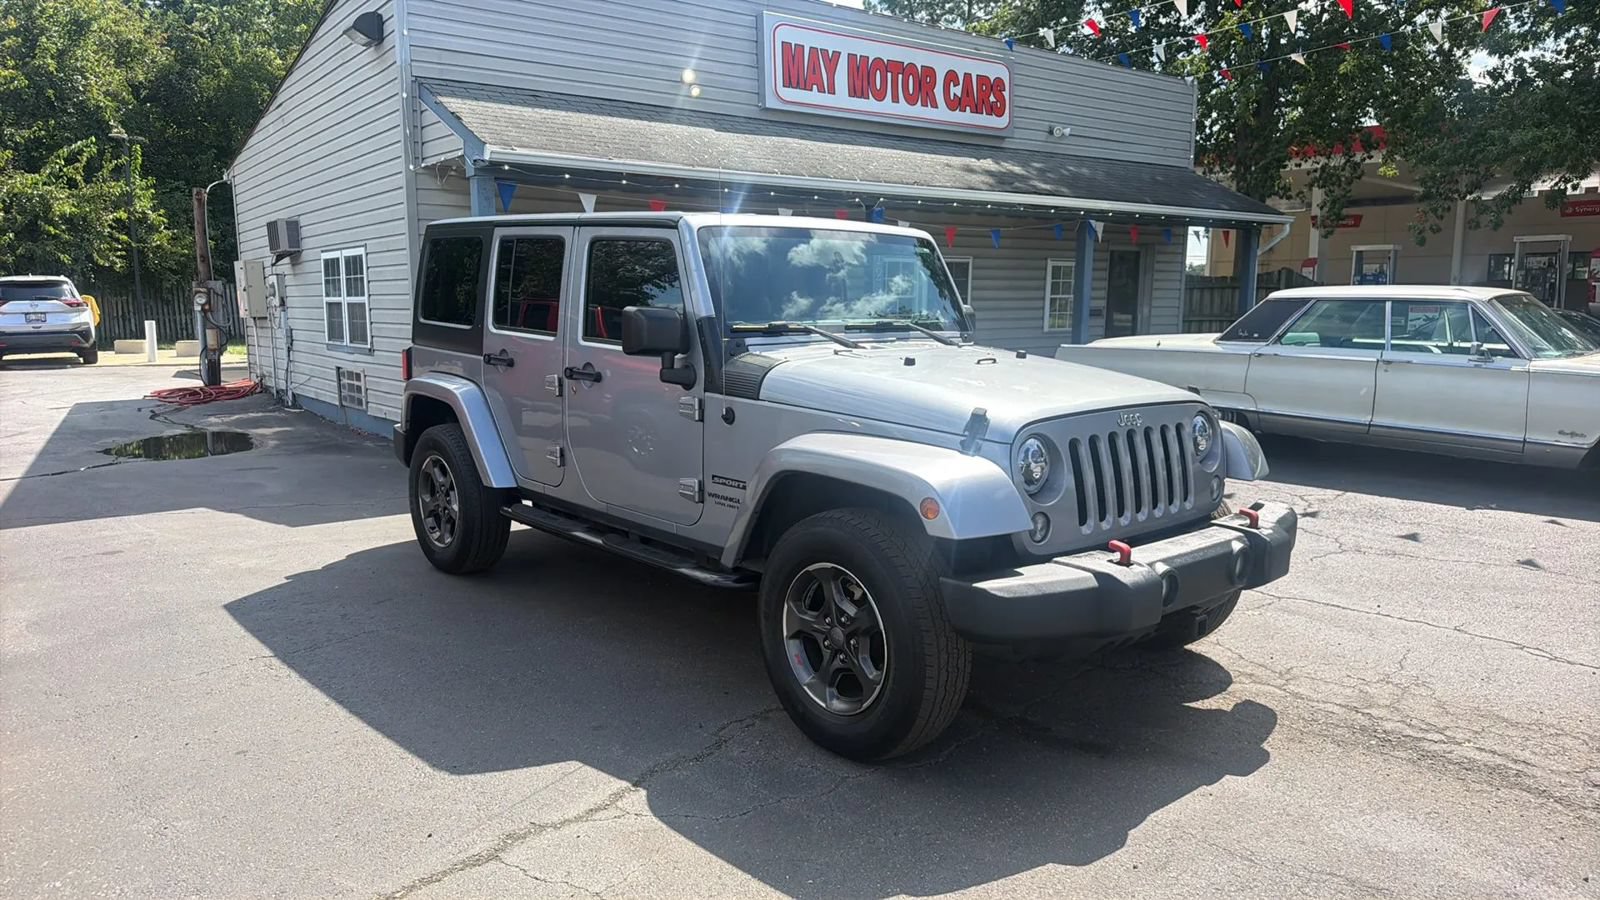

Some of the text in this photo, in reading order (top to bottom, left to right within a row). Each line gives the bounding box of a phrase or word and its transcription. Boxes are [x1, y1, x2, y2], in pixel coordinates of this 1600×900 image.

[781, 41, 1006, 118] MAY MOTOR CARS
[1117, 411, 1142, 427] Jeep
[712, 475, 746, 490] SPORT
